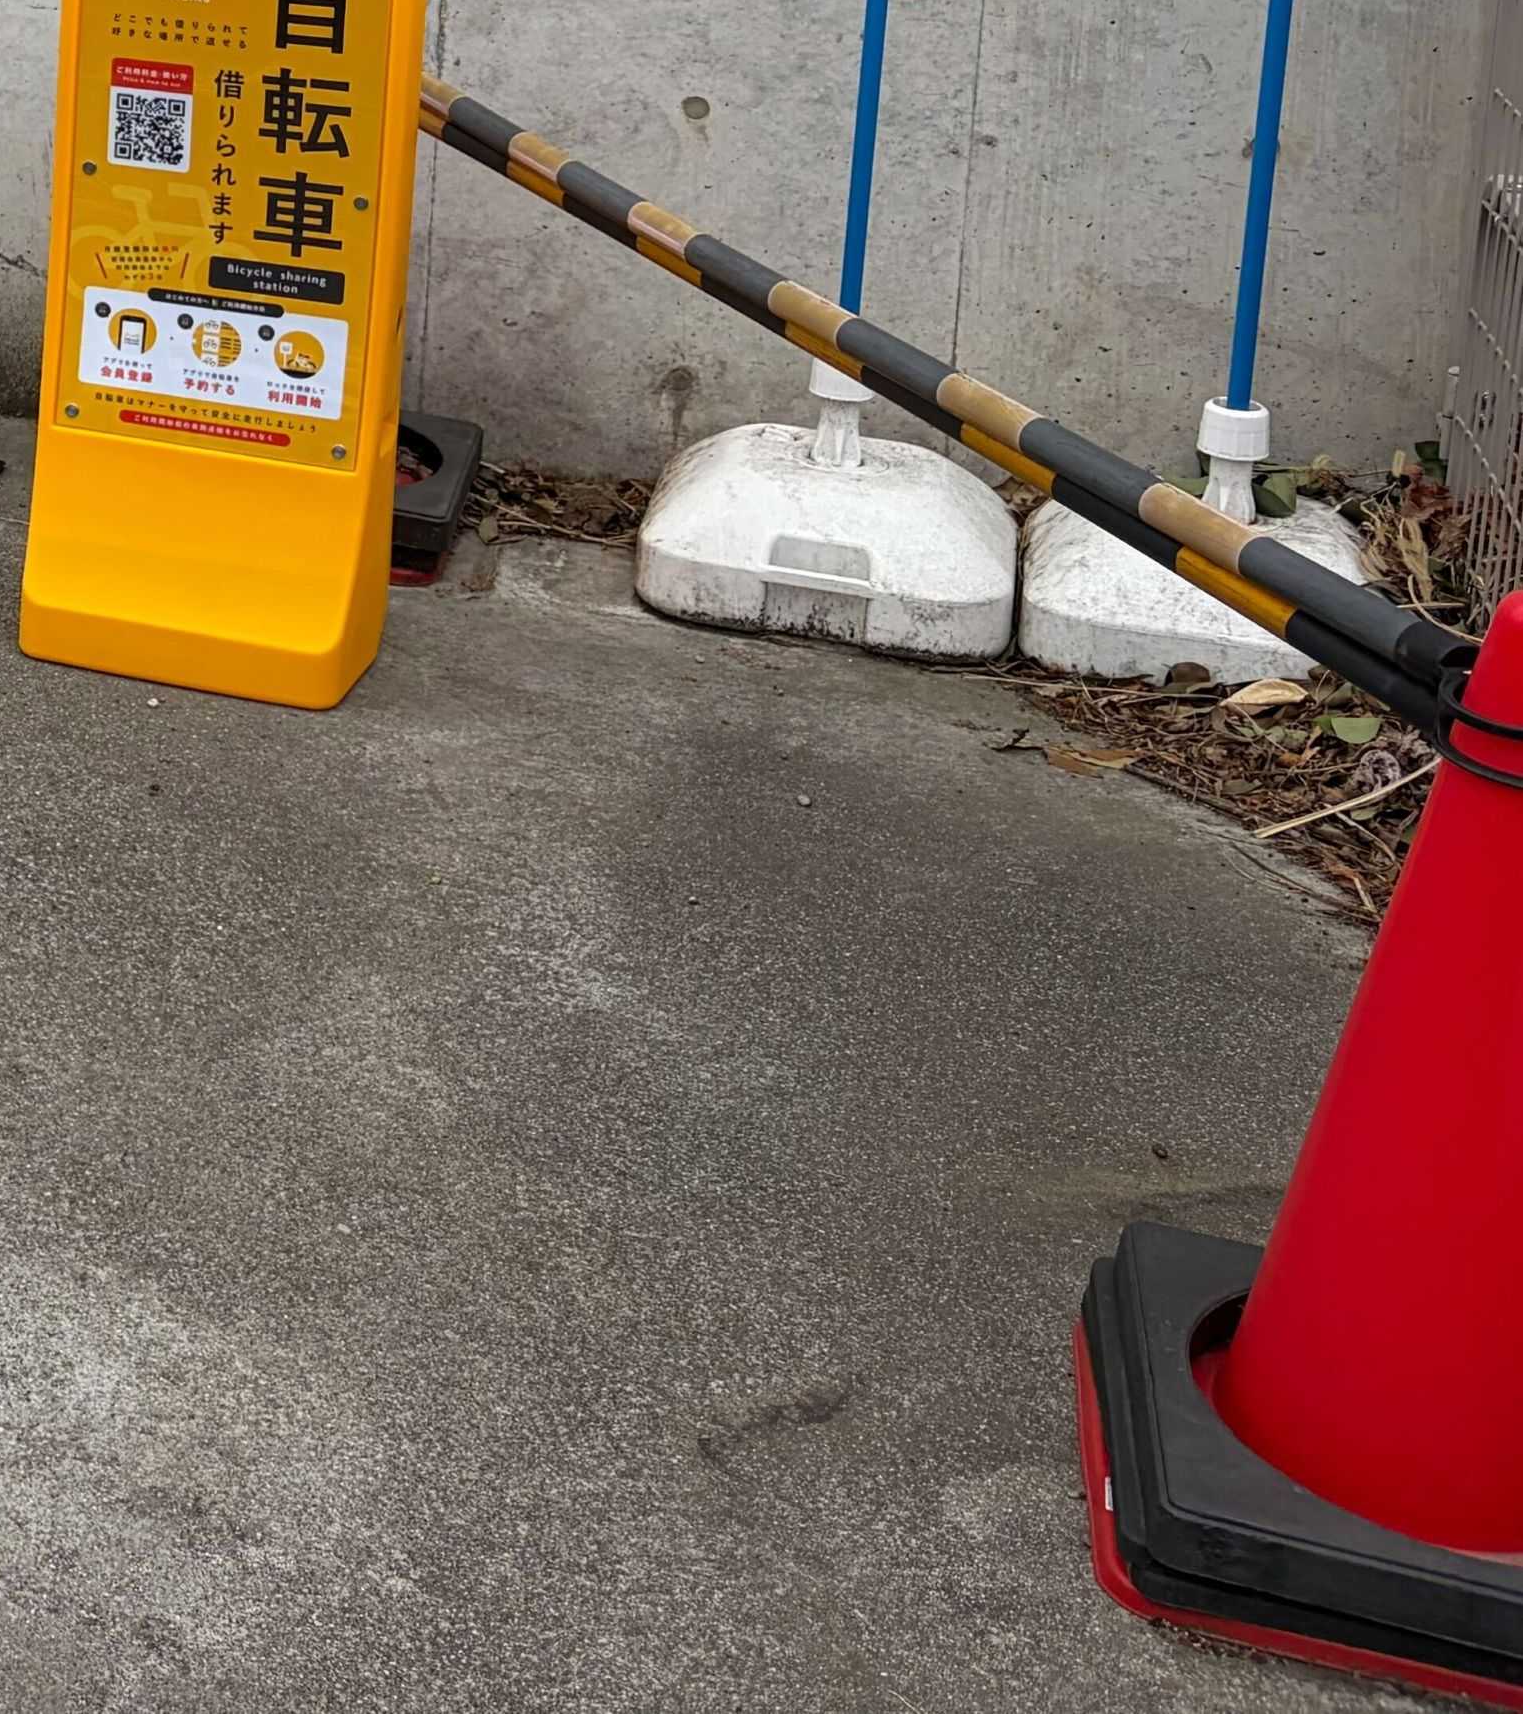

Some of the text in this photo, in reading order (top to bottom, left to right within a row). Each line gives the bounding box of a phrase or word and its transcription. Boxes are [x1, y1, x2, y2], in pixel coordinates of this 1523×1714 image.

[113, 13, 248, 35] どこでも借りられて
[111, 26, 247, 49] 好きな場所で返せる
[209, 68, 245, 245] 借りられます
[227, 263, 327, 288] Bicycle sharing
[253, 280, 299, 294] station
[100, 365, 153, 383] 会員登録
[184, 377, 235, 396] 予約する
[268, 390, 322, 409] 利用開始
[95, 392, 316, 433] 自転車はマナーを守って安全に走行しましょう
